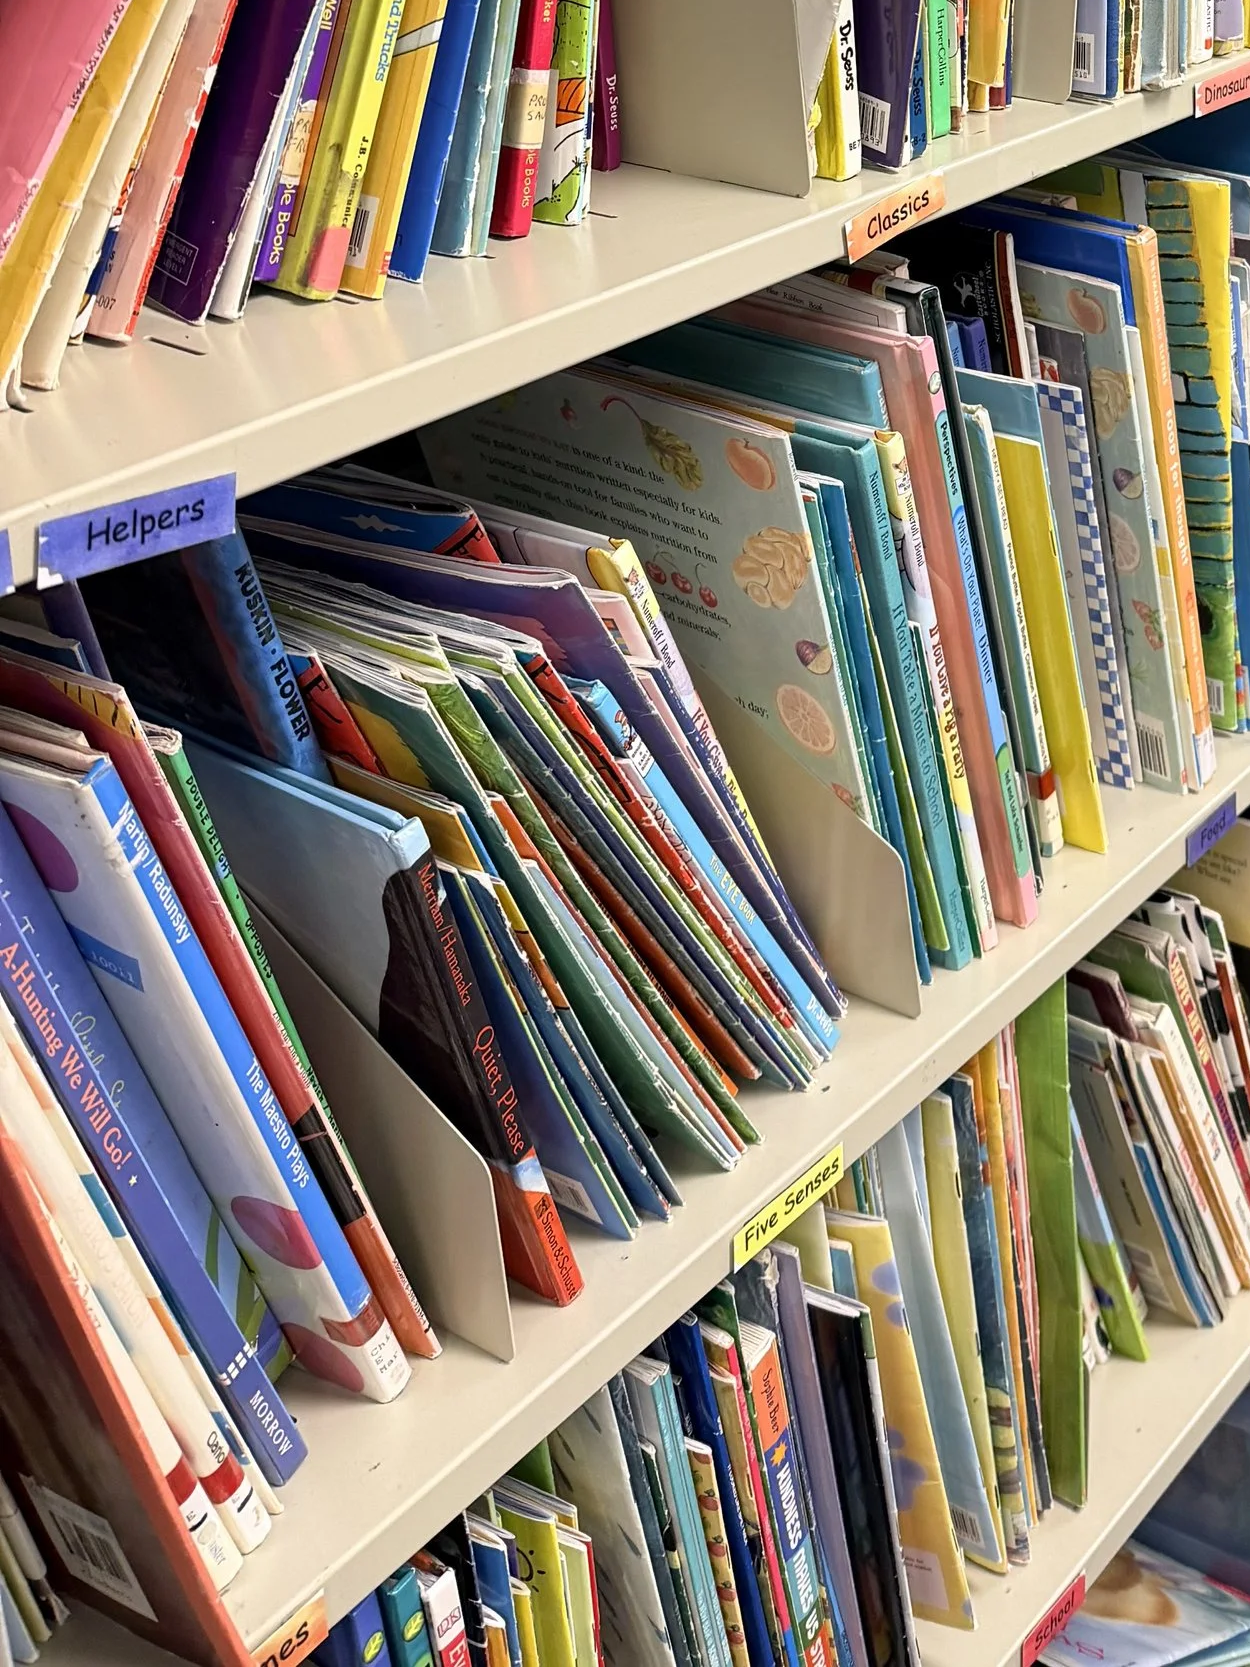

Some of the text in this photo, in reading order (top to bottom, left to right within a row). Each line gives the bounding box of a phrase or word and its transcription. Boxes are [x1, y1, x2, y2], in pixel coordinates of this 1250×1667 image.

[374, 8, 403, 83] Trucks
[838, 20, 858, 91] Dr. Seuss
[936, 9, 947, 86] HarperCollins
[605, 74, 621, 130] Dr. Seuss
[520, 167, 536, 209] Books
[867, 190, 931, 240] Classics
[268, 210, 292, 266] Books
[622, 460, 665, 485] kind: the
[937, 420, 962, 495] Perspectives
[86, 496, 206, 552] Helpers
[597, 472, 723, 527] written especially for kids.
[610, 494, 710, 541] families who want to
[867, 470, 892, 559] Numeroff Bond
[1169, 462, 1191, 566] for thought
[610, 510, 719, 564] explains nutrition from
[639, 597, 676, 672] Numeroff Bond
[953, 516, 994, 684] What's On Your Plate? Dinner
[234, 560, 311, 744] KUSKIN FLOWER
[889, 603, 944, 827] If You Take Mouse to School
[931, 640, 968, 780] You Give Pig Party
[1201, 811, 1227, 849] Food
[118, 798, 193, 945] Martin Radunsky
[185, 773, 274, 980] DOUBLE DELIGHT OPPOSITES
[721, 875, 743, 910] EYE
[417, 861, 474, 1007] Merriam/Hamanaka
[806, 995, 835, 1040] Dr. Seuss
[1169, 954, 1193, 1014] SHAPES
[0, 941, 64, 1054] A-Hunting
[59, 1045, 84, 1094] We
[80, 1084, 114, 1139] Will
[102, 1125, 134, 1173] Go!
[475, 1025, 526, 1155] Quiet, Please
[245, 1055, 269, 1099] The
[258, 1089, 296, 1154] Maestro
[285, 1139, 312, 1190] Plays
[744, 1155, 841, 1253] Five Senses
[380, 1350, 398, 1374] Mar
[248, 1388, 294, 1459] MORROW
[760, 1367, 780, 1435] Sophie Beer
[775, 1465, 804, 1551] KINDNESS
[437, 1607, 462, 1637] DK
[803, 1610, 820, 1641] US
[1034, 1593, 1076, 1651] School
